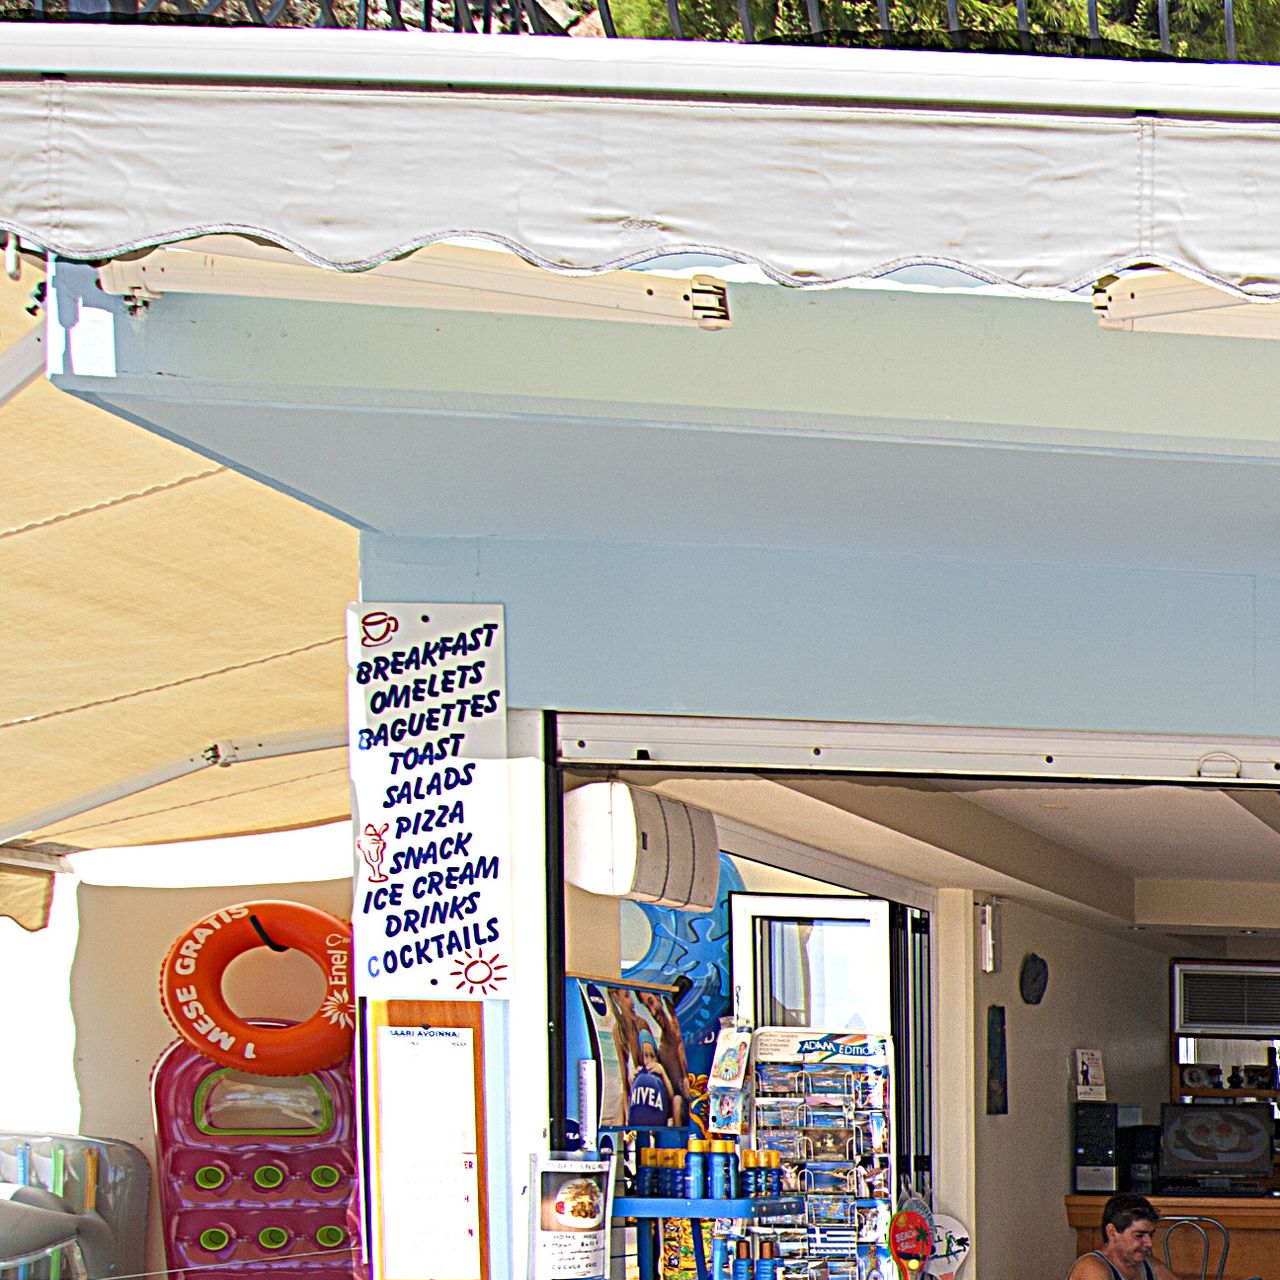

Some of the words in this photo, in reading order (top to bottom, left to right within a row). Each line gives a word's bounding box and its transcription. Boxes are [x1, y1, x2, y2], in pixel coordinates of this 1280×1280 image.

[356, 623, 498, 684] BREAKFAST
[370, 660, 485, 714] OMELETS
[358, 690, 500, 750] BAGUETTES
[389, 733, 465, 775] TOAST
[382, 763, 475, 809] SALADS
[394, 801, 464, 840] PIZZA
[389, 832, 472, 875] SNACK
[363, 883, 403, 914] ICE
[412, 857, 499, 901] CREAM
[175, 905, 249, 975] GRATIS
[385, 892, 480, 938] DRINKS
[327, 949, 348, 986] Enel
[368, 917, 499, 977] COCKTAILS
[176, 984, 236, 1051] MESE
[631, 1086, 664, 1112] NIVEA
